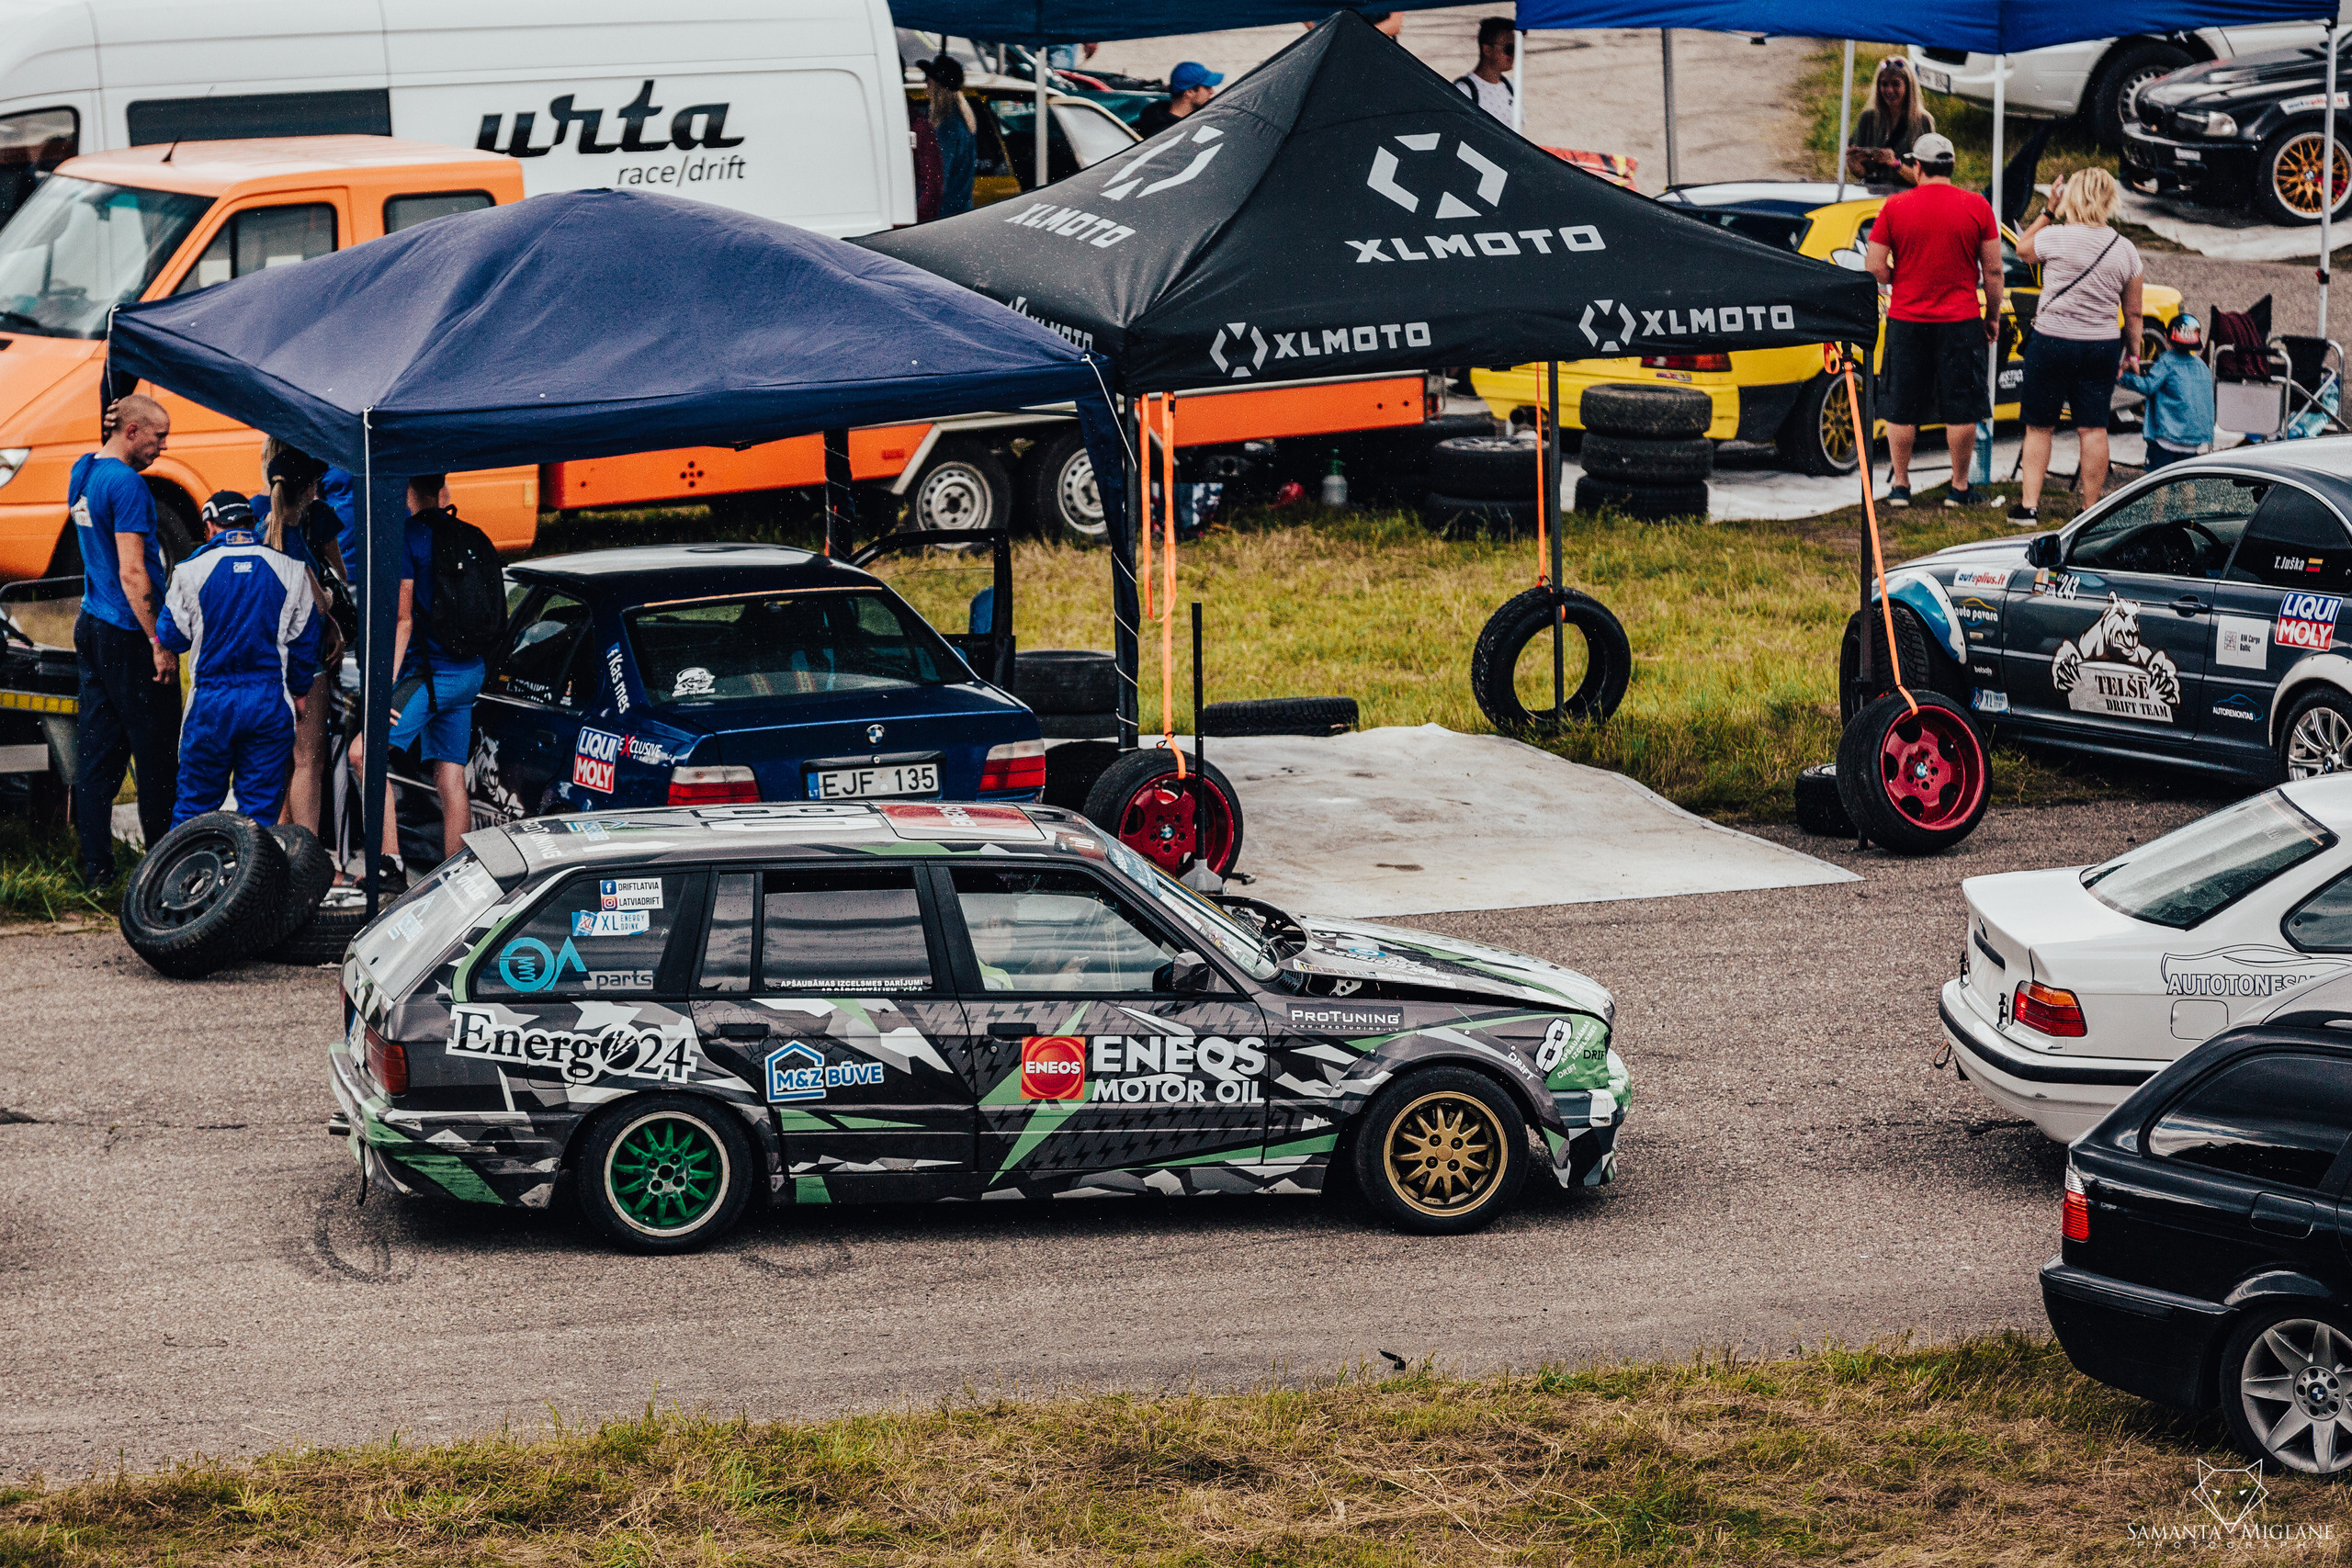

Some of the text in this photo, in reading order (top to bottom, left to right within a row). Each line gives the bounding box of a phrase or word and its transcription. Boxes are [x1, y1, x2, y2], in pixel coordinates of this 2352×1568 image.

[617, 154, 746, 187] race/drift
[1004, 203, 1136, 249] XLMOTO
[1344, 224, 1607, 264] XLMOTO
[1641, 305, 1795, 337] XLMOTO
[1273, 321, 1432, 359] XLMOTO
[2282, 593, 2339, 622] LIQUI
[2278, 618, 2333, 648] MOLY
[2106, 698, 2169, 717] DRIFT TEAM
[578, 729, 619, 762] LIQUI
[575, 756, 614, 790] MOLY
[808, 766, 935, 797] LT EJF 135
[617, 881, 660, 891] DRIFTLATVIA
[618, 896, 661, 907] LATVIADRIFT
[601, 914, 646, 931] XL ENERGY
[620, 922, 639, 931] DRINK
[595, 971, 653, 990] parts
[837, 979, 883, 987] IZCELSMES
[885, 978, 923, 987] DARĪJUMI
[1025, 1060, 1081, 1075] ENEOS
[1092, 1036, 1267, 1076] ENEOS
[1508, 1052, 1534, 1081] DRIFT
[775, 1062, 883, 1091] M&Z BŪVE
[1556, 1063, 1577, 1079] DRIFT
[1091, 1079, 1265, 1103] MOTOR OIL
